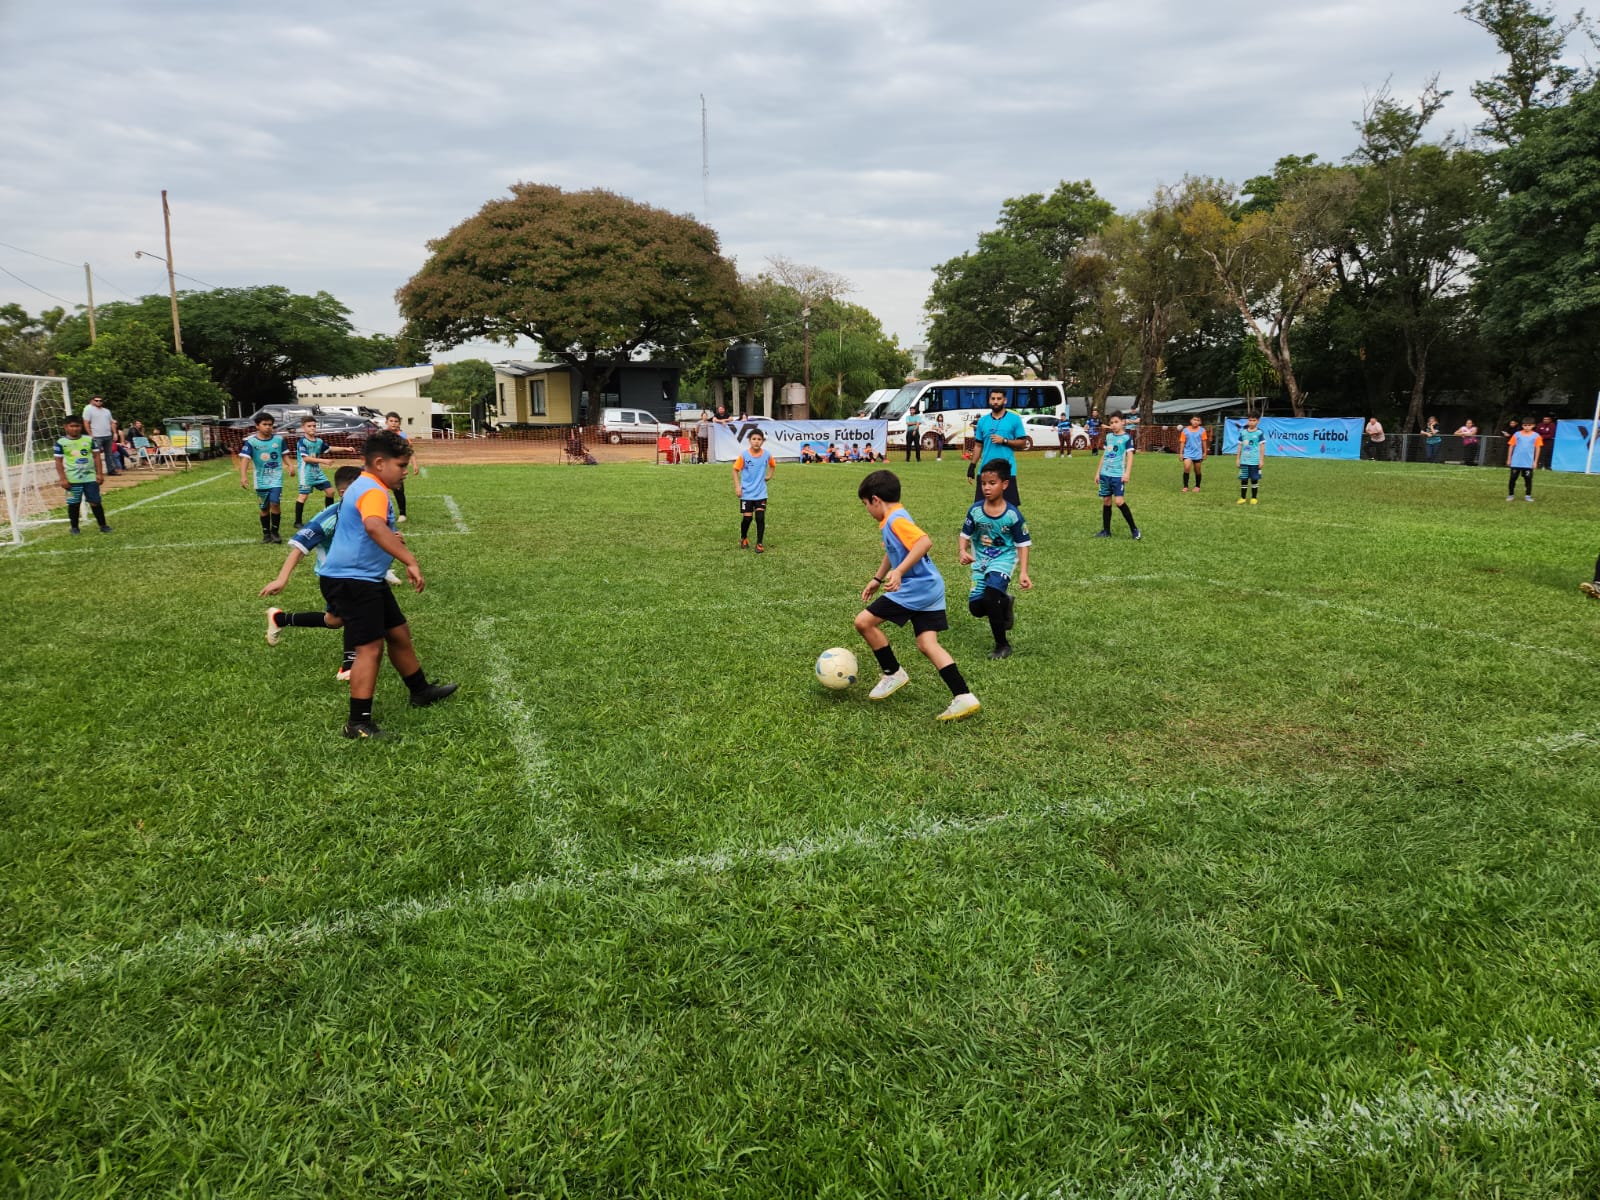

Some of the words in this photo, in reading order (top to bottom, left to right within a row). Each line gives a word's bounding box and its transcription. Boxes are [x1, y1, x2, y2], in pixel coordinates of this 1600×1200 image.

[775, 430, 830, 441] Vivamos
[834, 428, 874, 441] Fútbol
[1268, 429, 1310, 441] Vivamos
[1313, 428, 1349, 441] Fútbol
